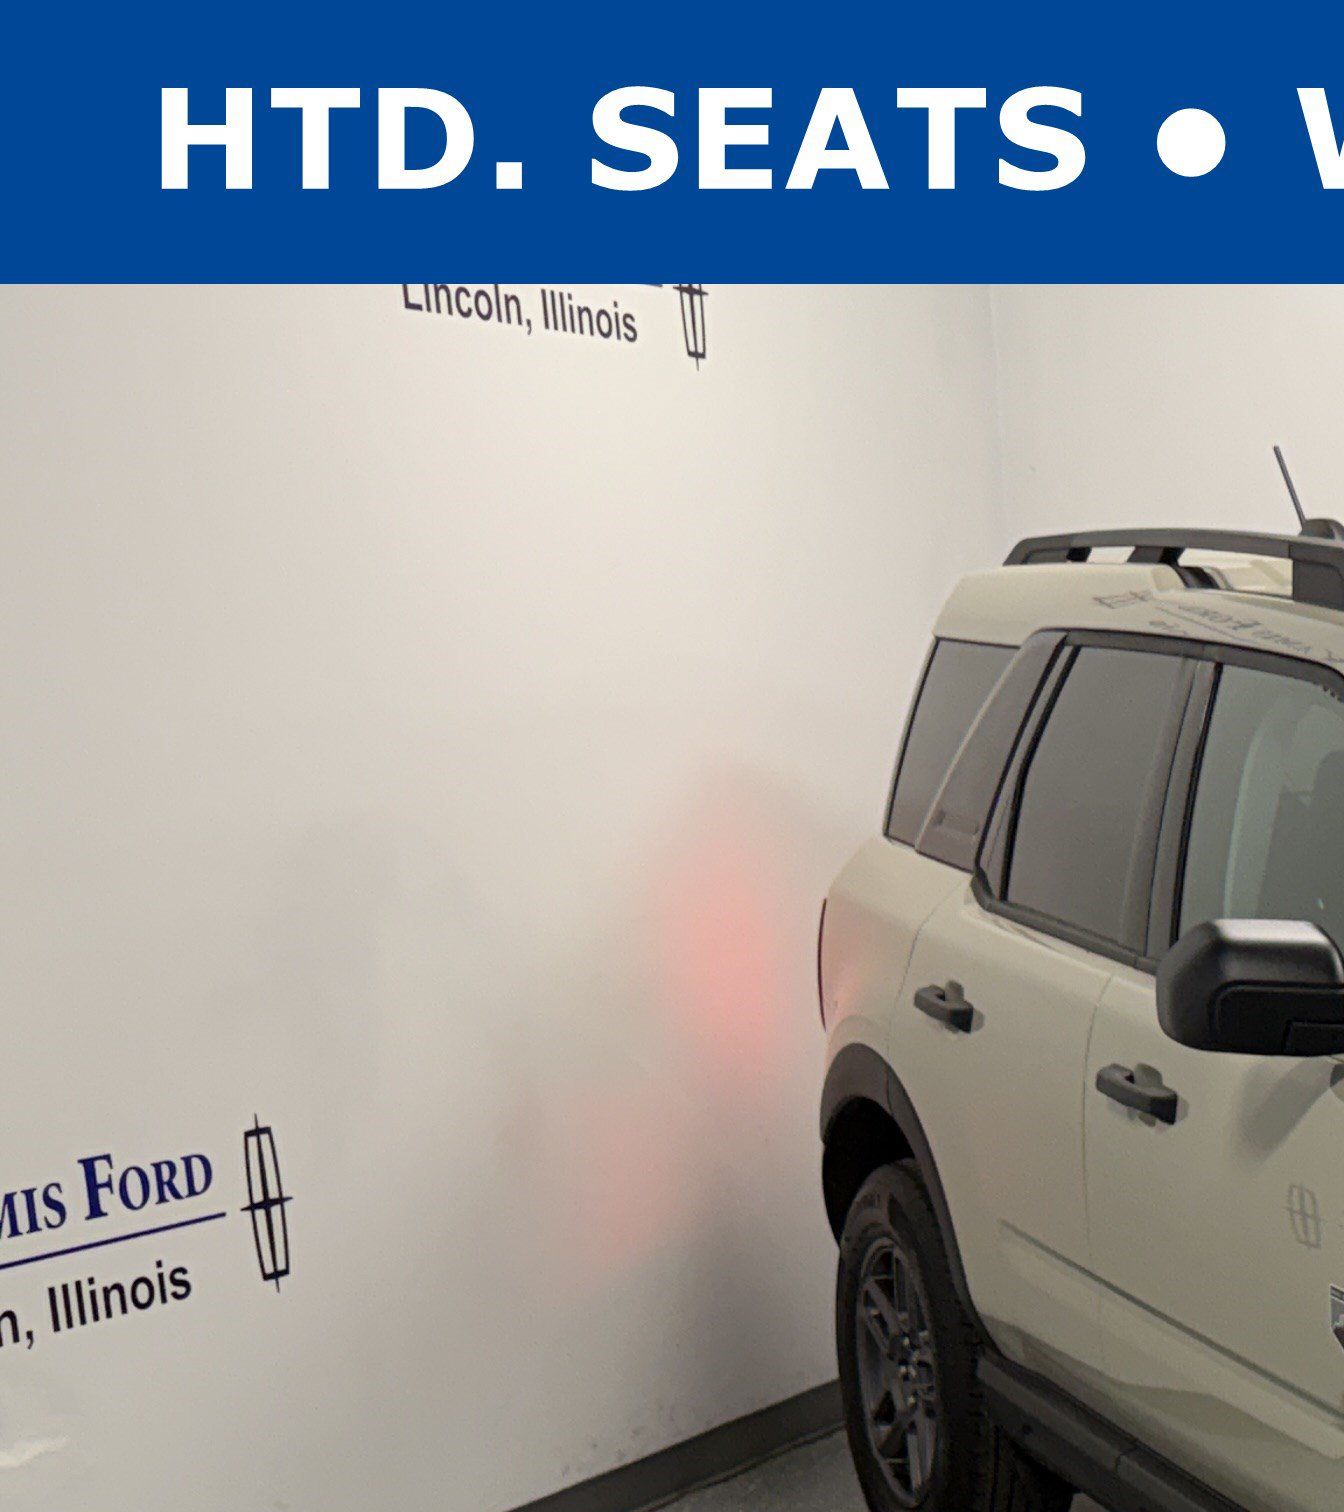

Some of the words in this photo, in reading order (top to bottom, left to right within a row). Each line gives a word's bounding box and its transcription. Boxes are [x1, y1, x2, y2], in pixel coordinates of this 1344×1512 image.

[402, 284, 532, 335] Lincoln,
[540, 288, 638, 343] Illinois
[77, 1153, 213, 1221] FORD
[48, 1259, 192, 1333] Illinois
